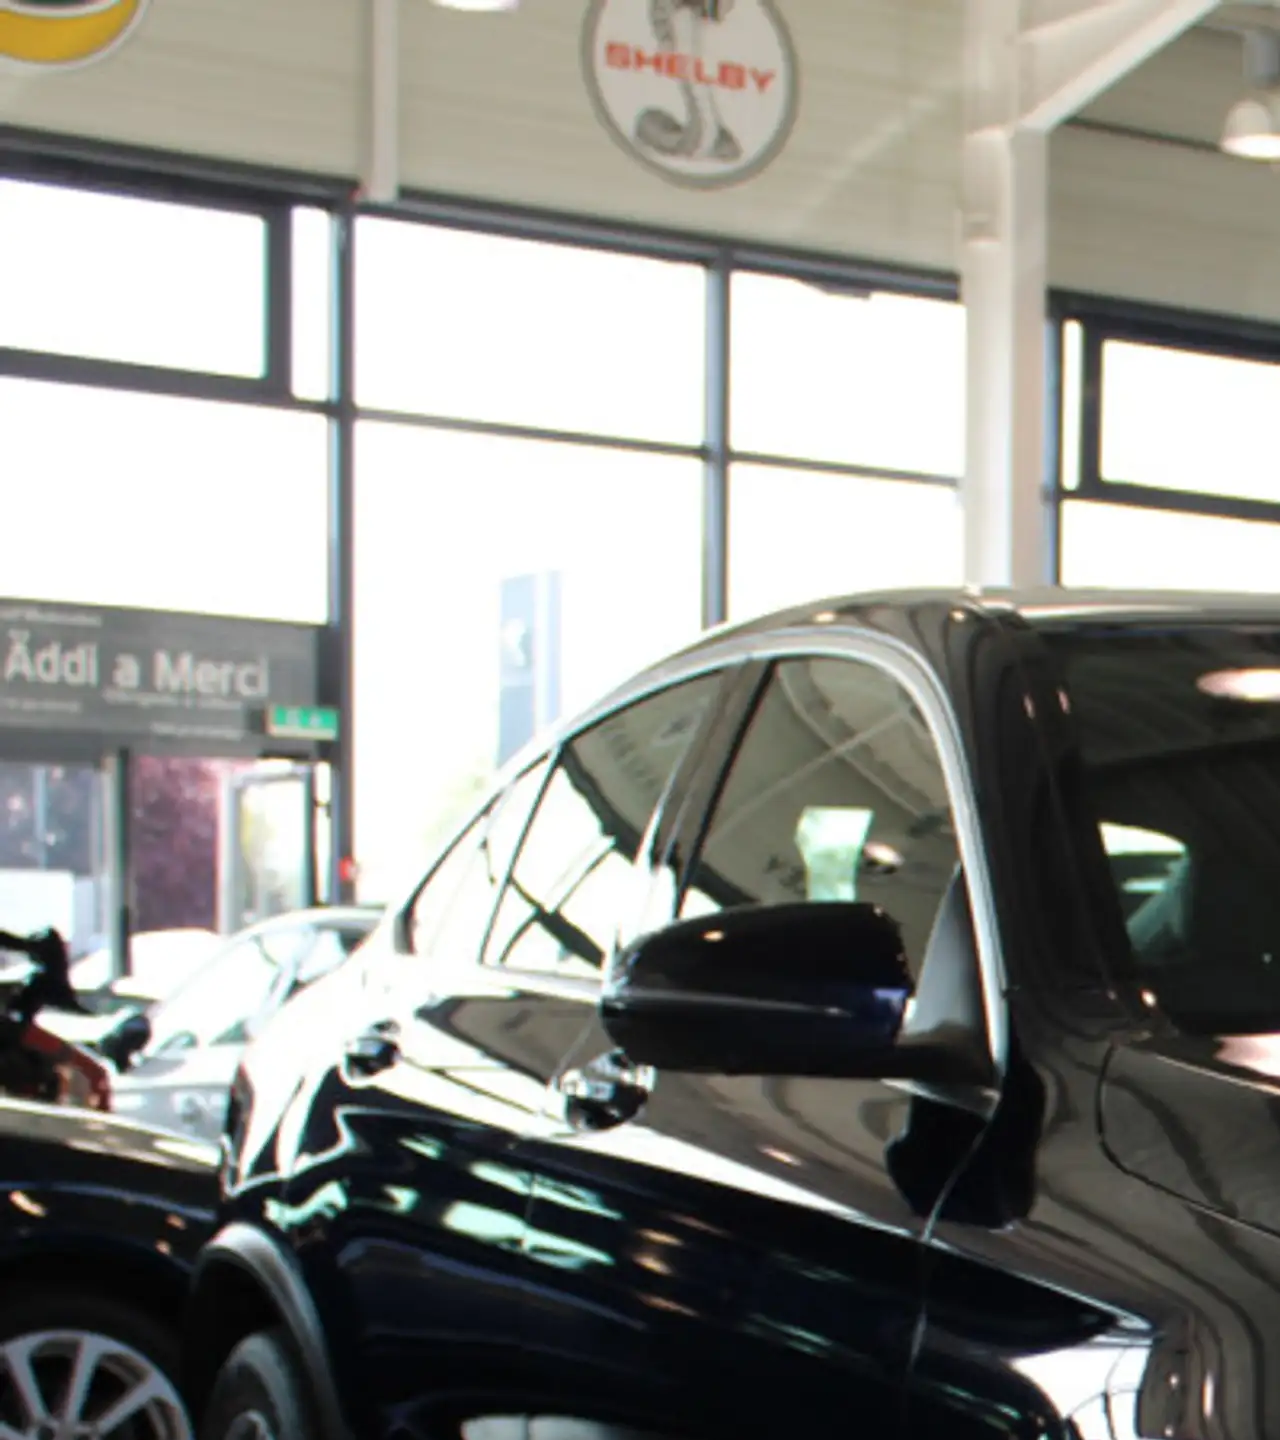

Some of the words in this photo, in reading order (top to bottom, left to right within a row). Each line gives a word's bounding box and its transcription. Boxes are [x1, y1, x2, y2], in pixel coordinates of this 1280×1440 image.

[605, 40, 775, 94] SHELBY
[112, 653, 140, 690] a
[154, 648, 269, 698] Merci
